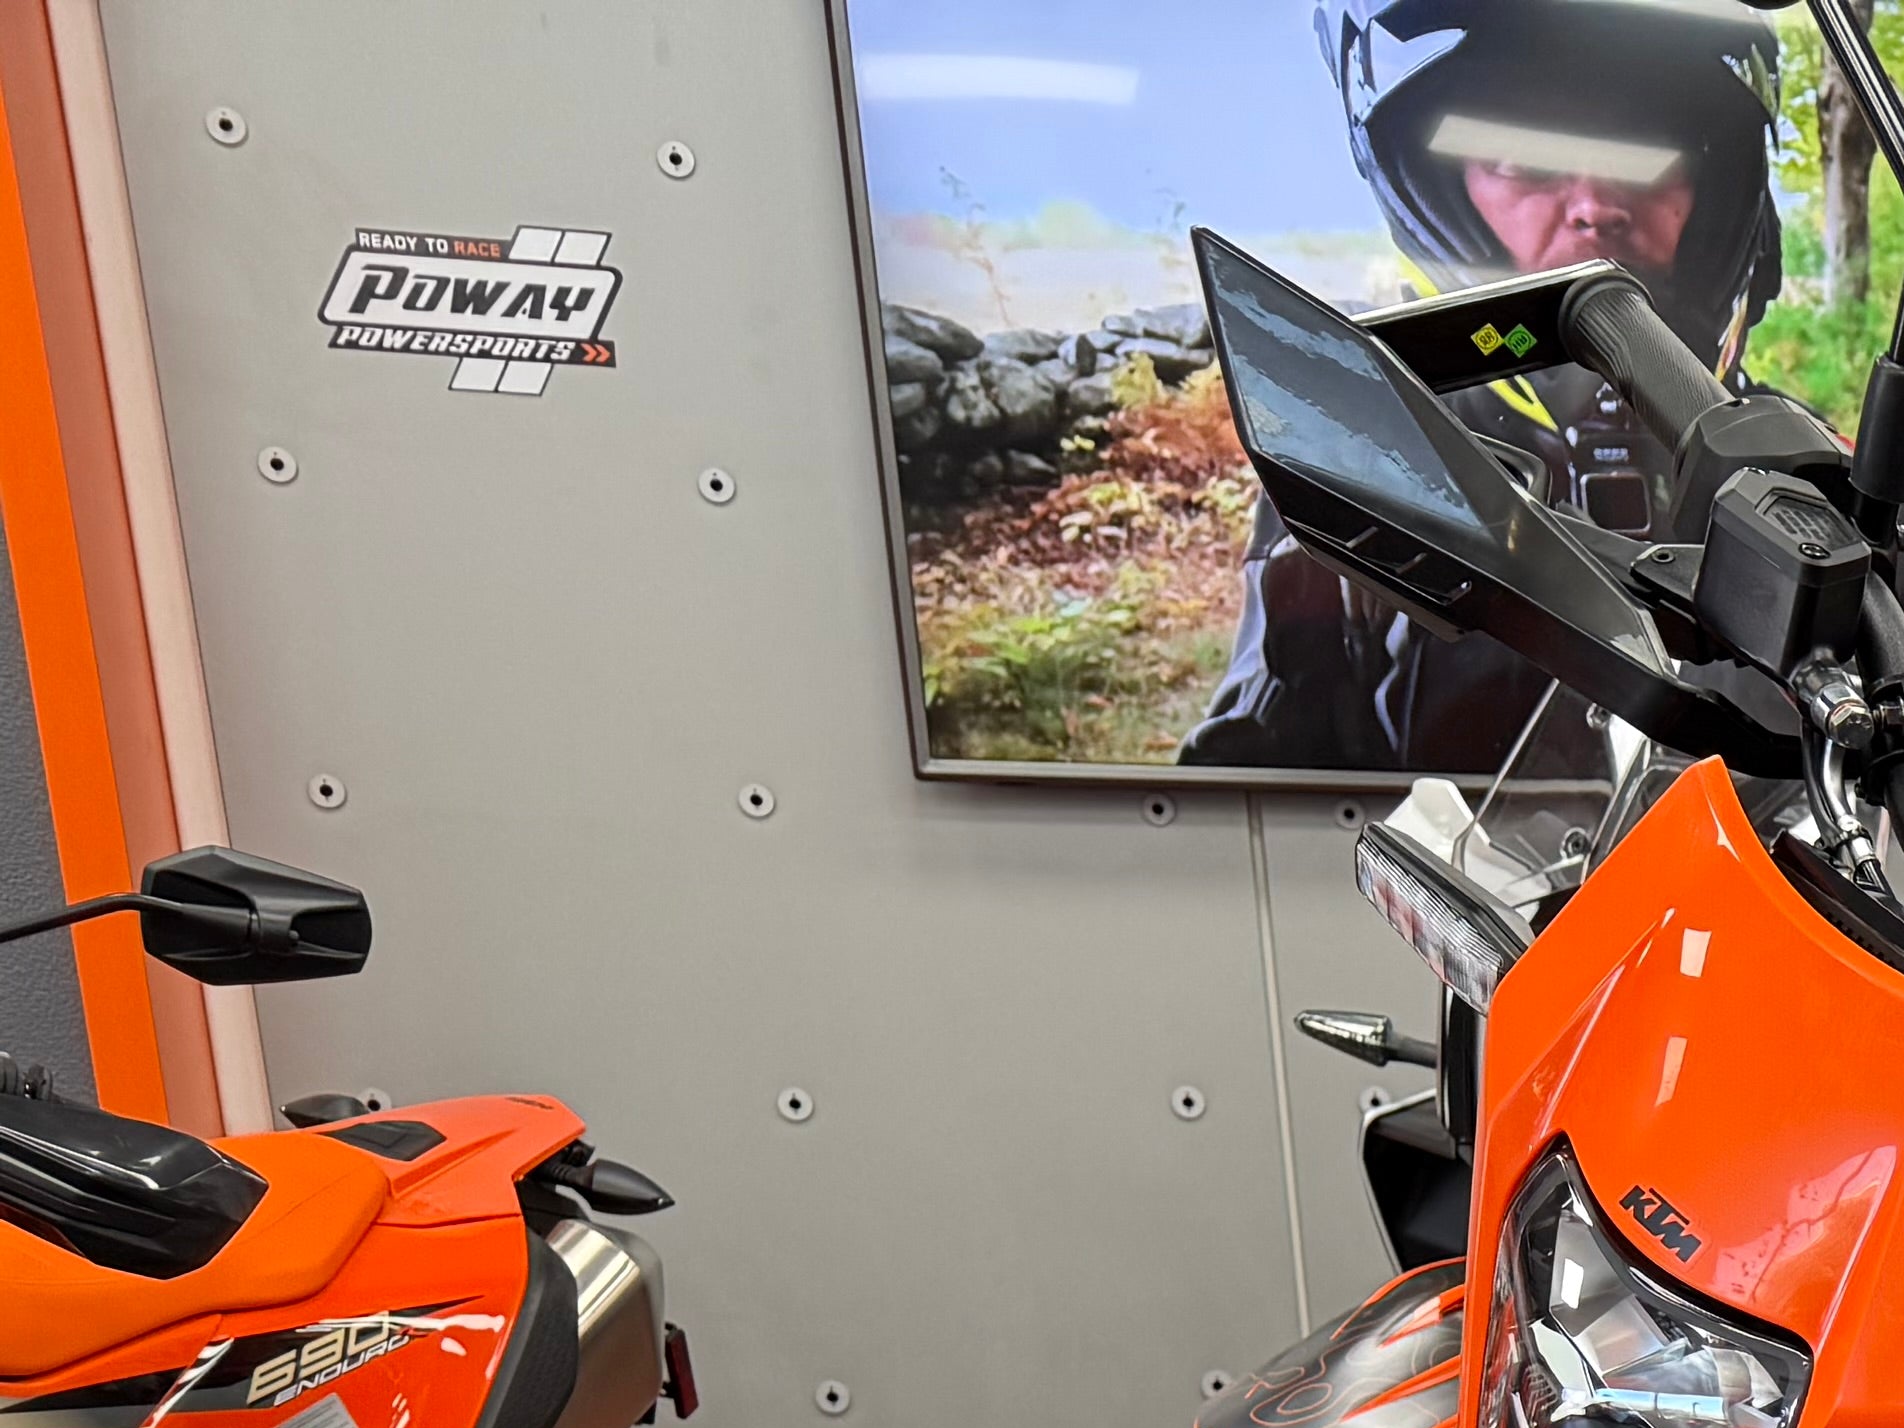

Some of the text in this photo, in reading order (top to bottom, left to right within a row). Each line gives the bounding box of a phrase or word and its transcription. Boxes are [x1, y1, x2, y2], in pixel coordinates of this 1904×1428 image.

[358, 232, 501, 257] READY TO RACE
[347, 263, 595, 322] POWAY
[336, 325, 575, 360] POWERSPORTS
[1619, 1185, 1702, 1263] KTM
[246, 1310, 390, 1405] 690
[273, 1334, 410, 1407] ENDURO
